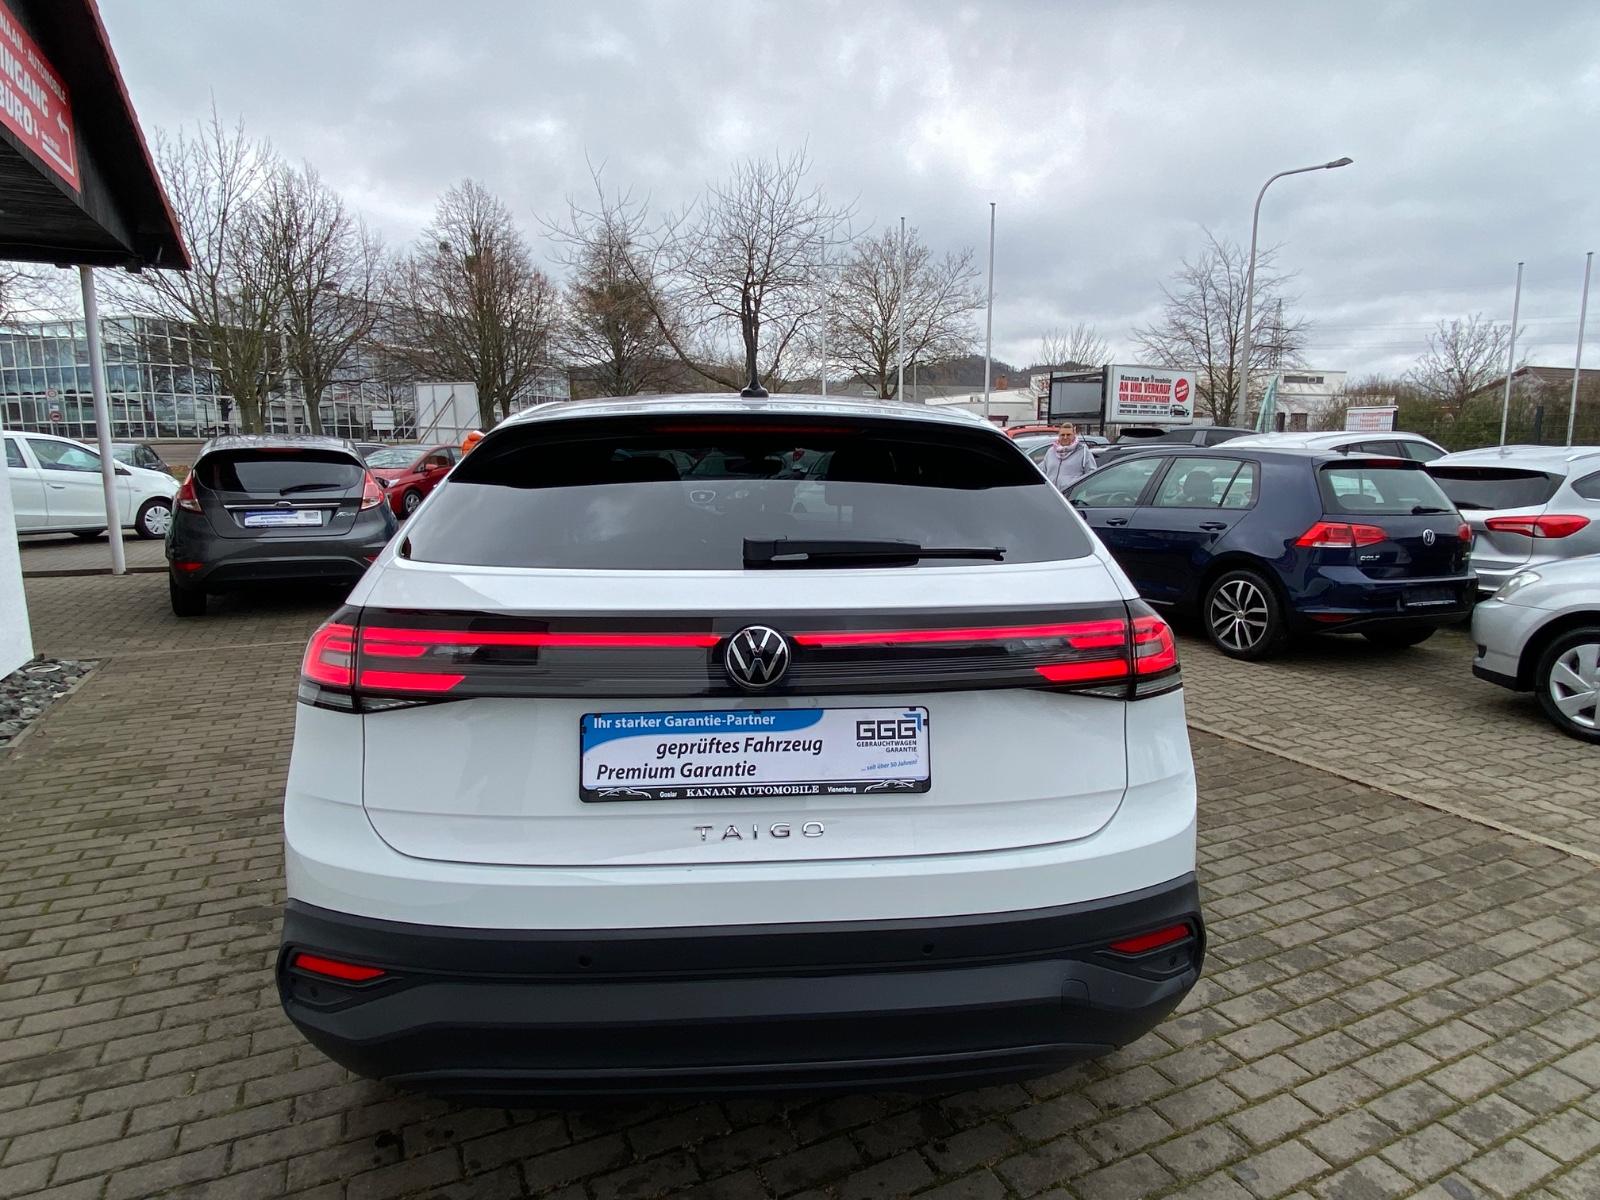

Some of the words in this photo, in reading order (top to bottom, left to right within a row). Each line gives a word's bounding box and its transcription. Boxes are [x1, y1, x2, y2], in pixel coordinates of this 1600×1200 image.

[1120, 382, 1129, 393] AN
[1131, 383, 1142, 393] UND
[1144, 383, 1171, 395] VERKAUF
[594, 717, 612, 729] Ihr
[615, 716, 661, 728] starker
[664, 714, 776, 728] Garantie-Partner
[856, 719, 917, 740] GGG
[656, 736, 740, 759] geprüftes
[744, 736, 823, 756] Fahrzeug
[856, 740, 917, 748] GEBRAUCHTWAGEN
[597, 763, 675, 780] Premium
[680, 761, 757, 778] Garantie
[686, 787, 737, 797] KANAAN
[740, 785, 820, 796] AUTOMOBILE
[828, 786, 857, 794] Vienenburg
[694, 820, 825, 841] TAIGO
